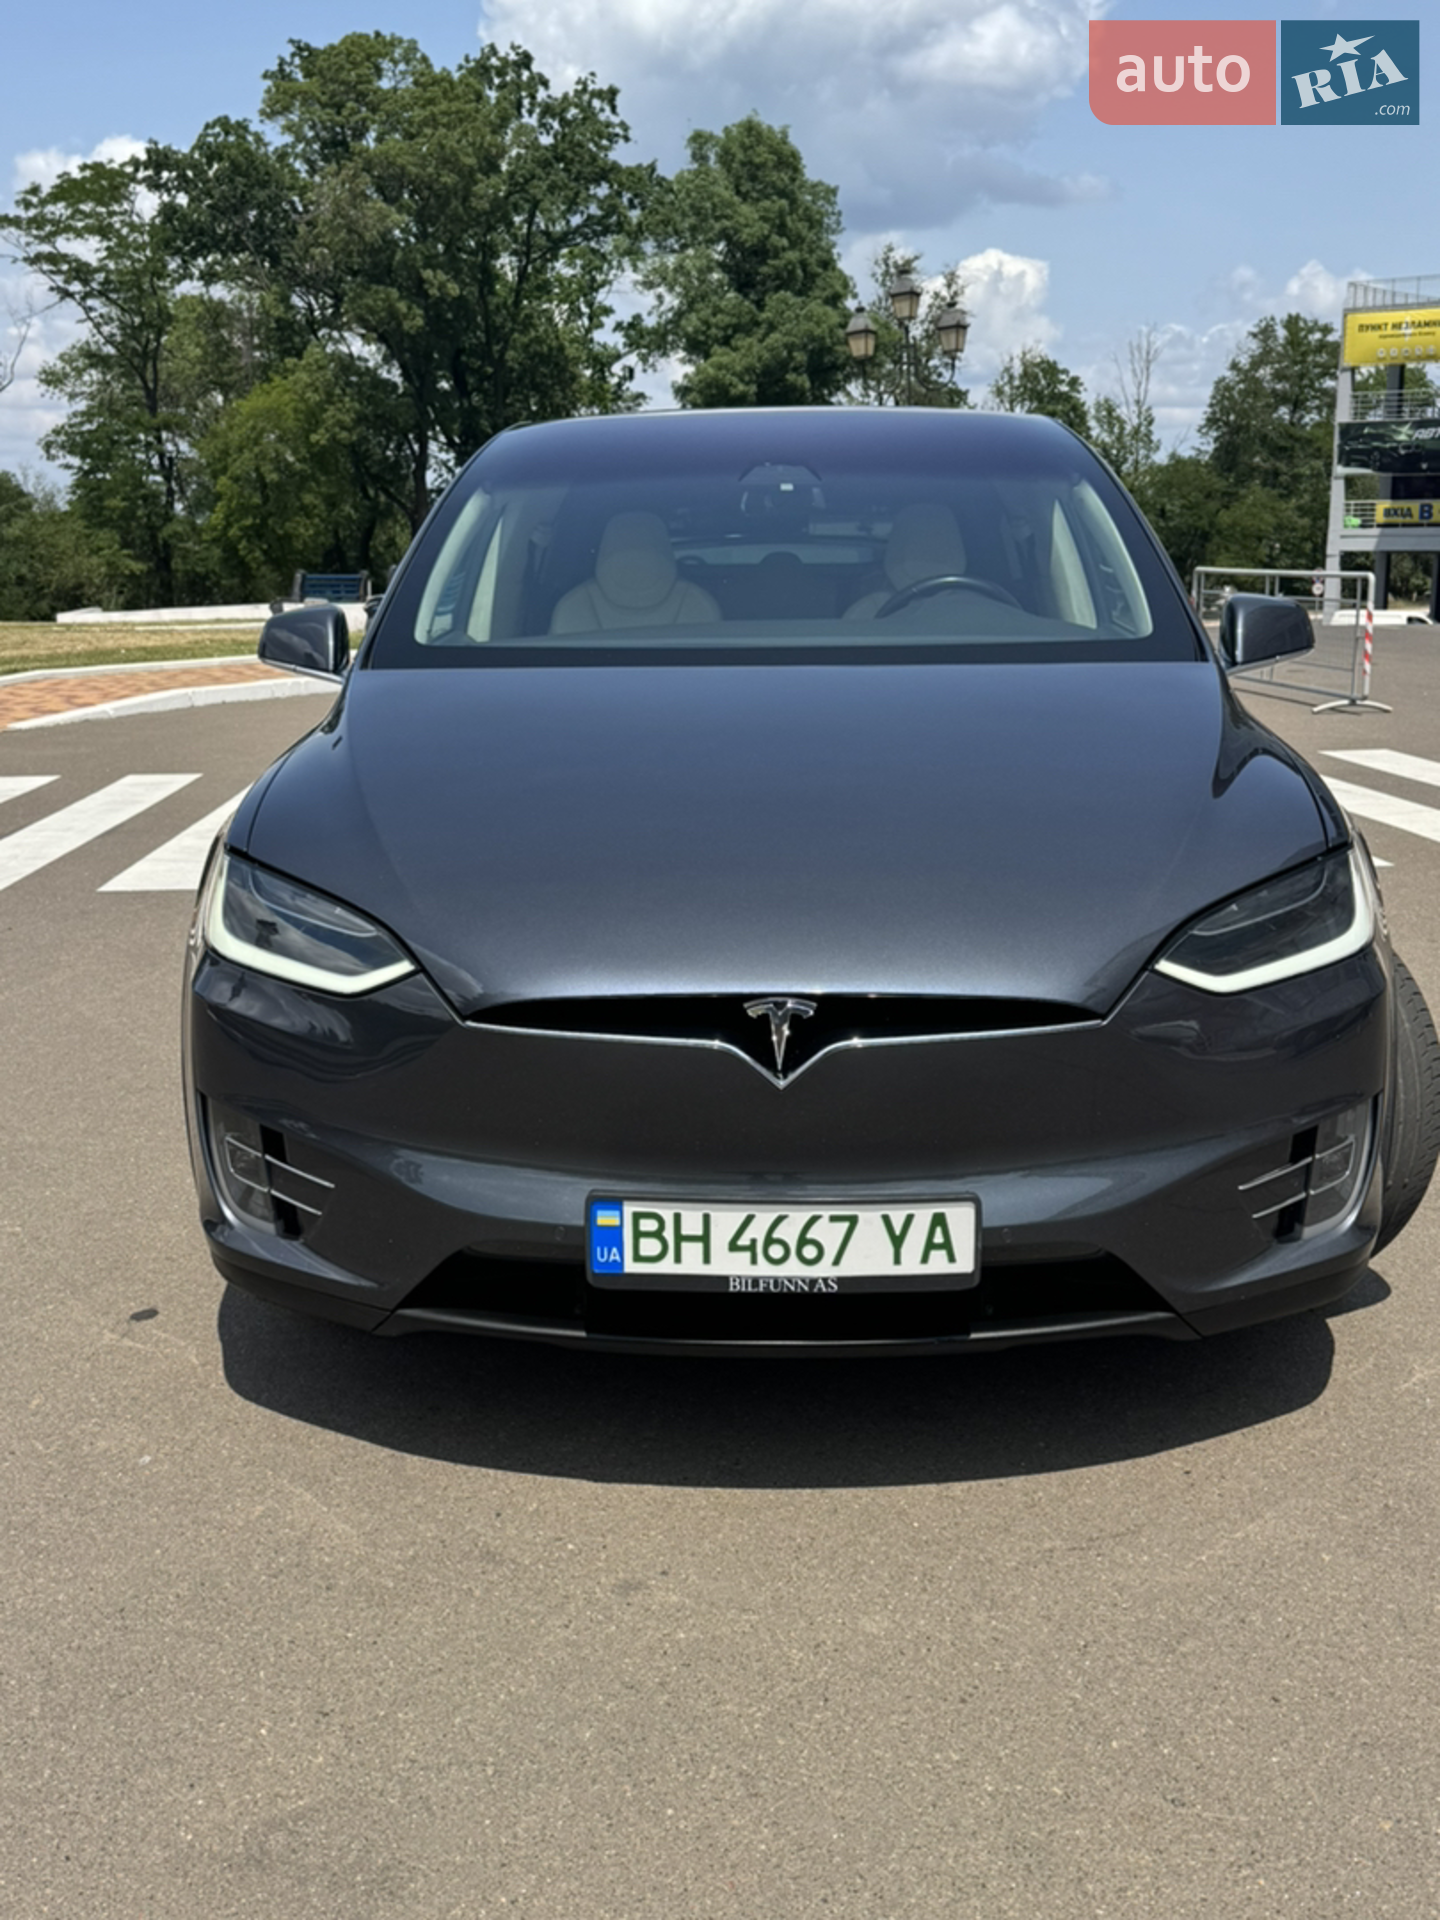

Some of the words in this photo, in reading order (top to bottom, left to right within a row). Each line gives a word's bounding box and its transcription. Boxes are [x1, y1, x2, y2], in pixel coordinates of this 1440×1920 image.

[631, 1211, 711, 1265] BH
[728, 1213, 859, 1267] 4667
[880, 1212, 957, 1266] YA
[597, 1246, 621, 1263] UA
[728, 1275, 809, 1293] BILFUNN
[813, 1275, 838, 1293] AS
